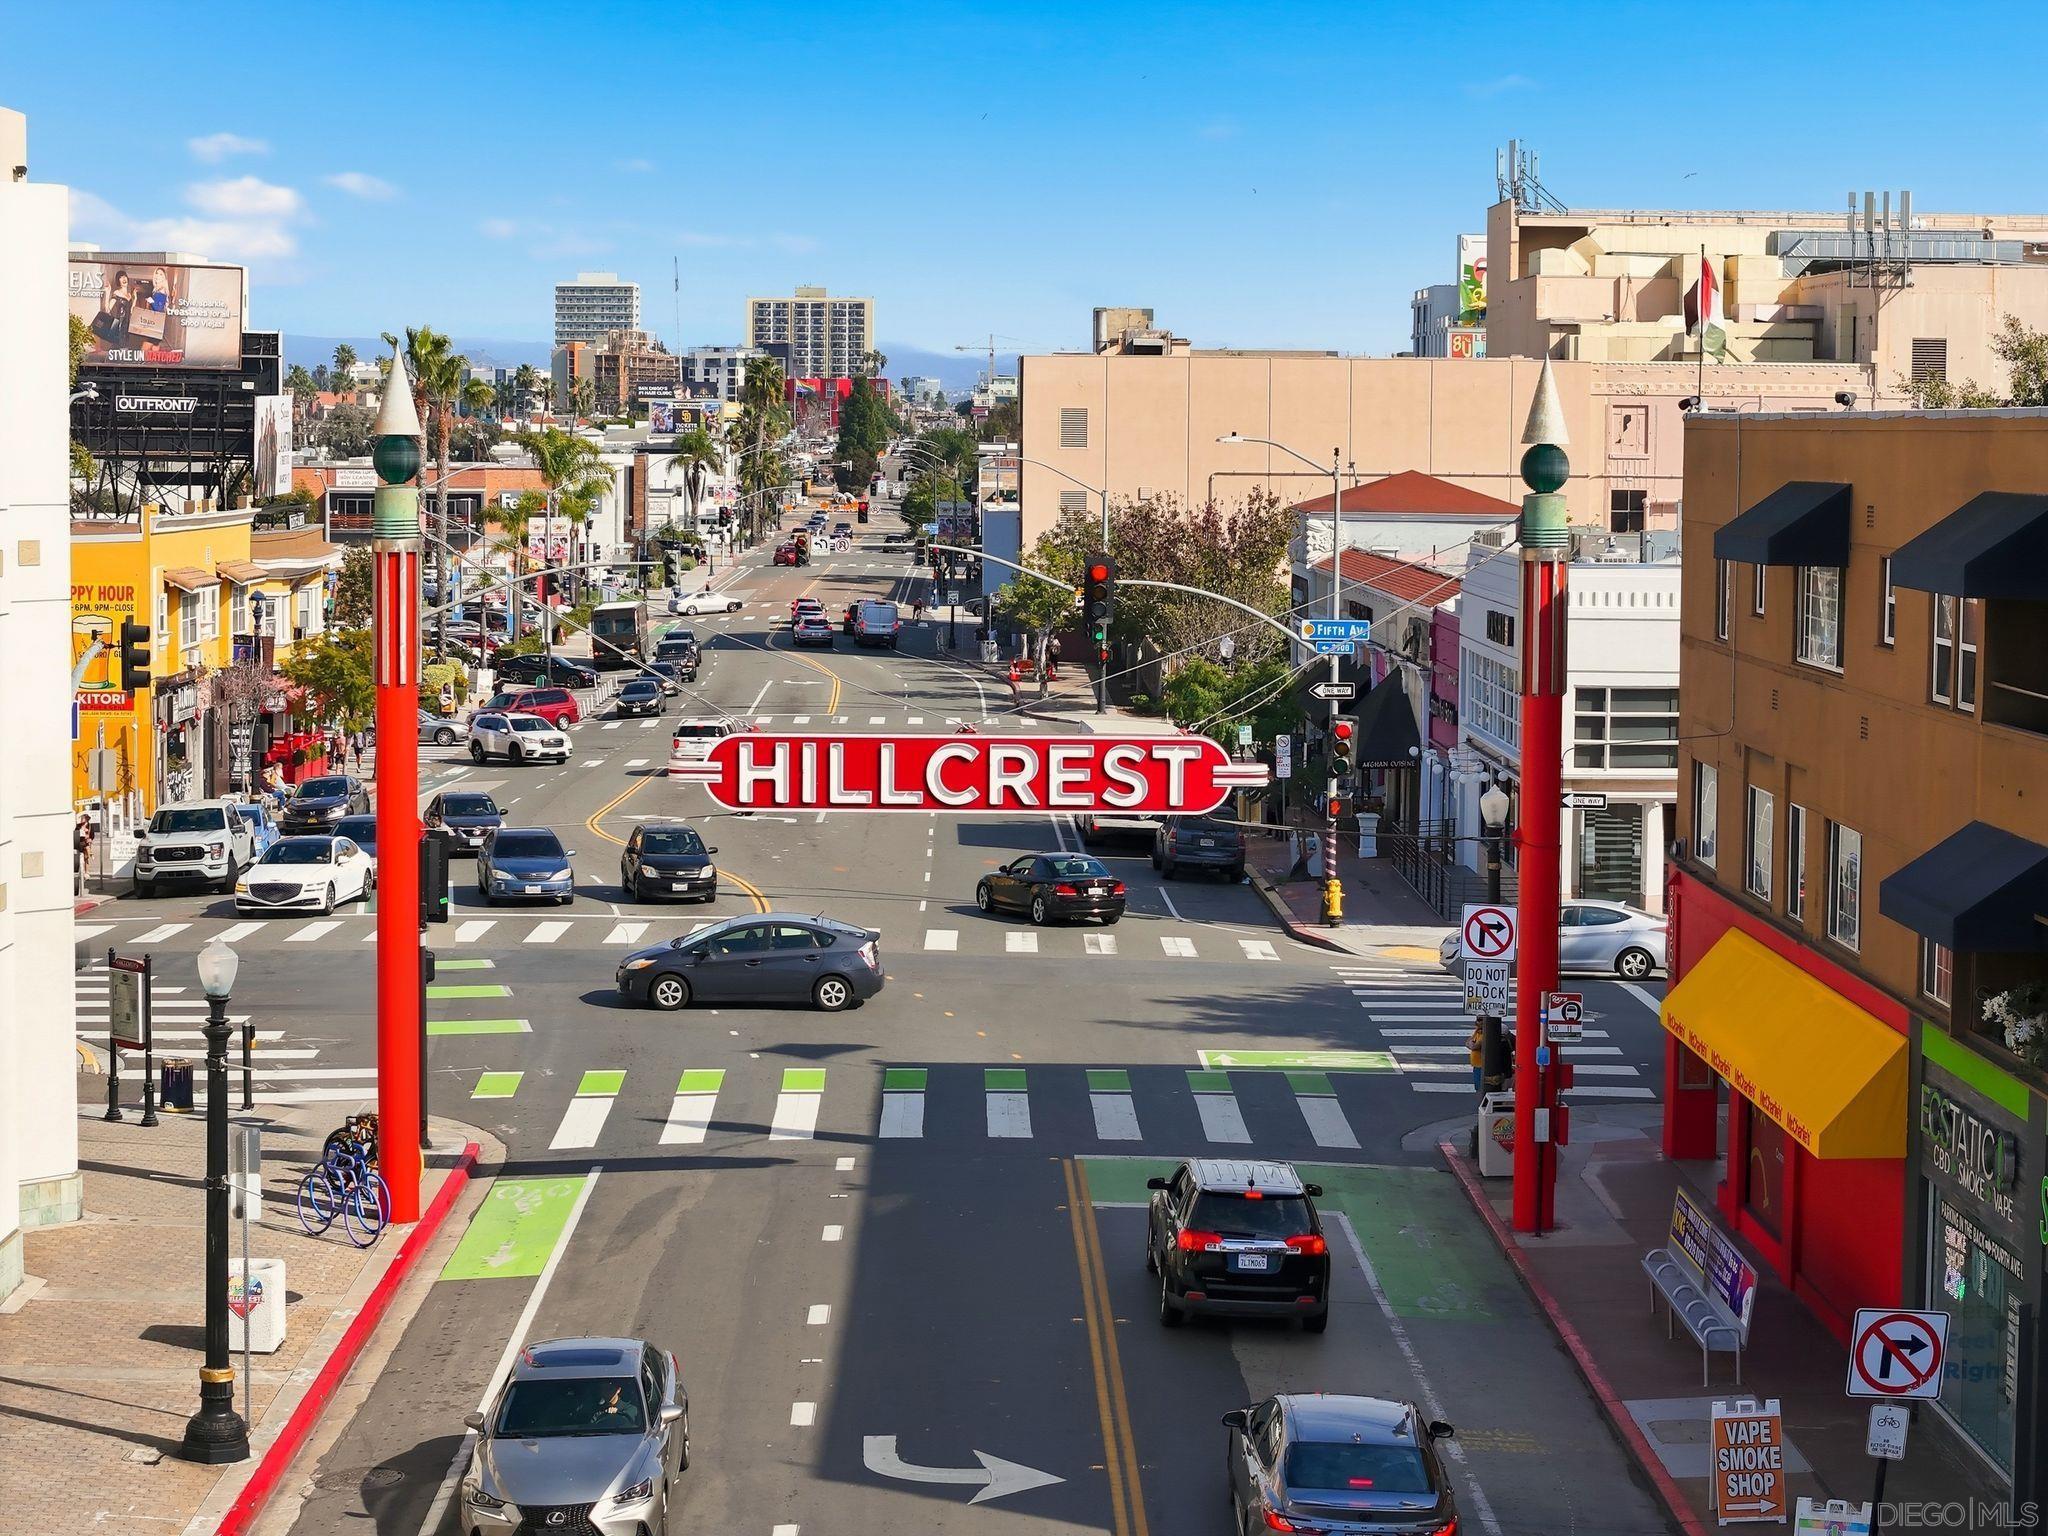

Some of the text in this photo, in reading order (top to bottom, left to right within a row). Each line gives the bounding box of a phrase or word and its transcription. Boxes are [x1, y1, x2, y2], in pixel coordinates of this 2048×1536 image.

[108, 350, 132, 361] STYLE
[98, 586, 134, 601] HOUR
[77, 693, 126, 705] KITORI
[738, 743, 1203, 806] HILLCREST
[1468, 968, 1506, 981] DO NOT
[1467, 986, 1506, 999] BLOCK
[1920, 1083, 1995, 1181] ECSTATIC
[1933, 1144, 1951, 1174] CBD
[1958, 1162, 1985, 1202] SMOKE
[1993, 1186, 2014, 1223] VAPE
[1724, 1420, 1772, 1445] VAPE
[1718, 1446, 1782, 1471] SMOKE
[1726, 1472, 1775, 1497] SHOP
